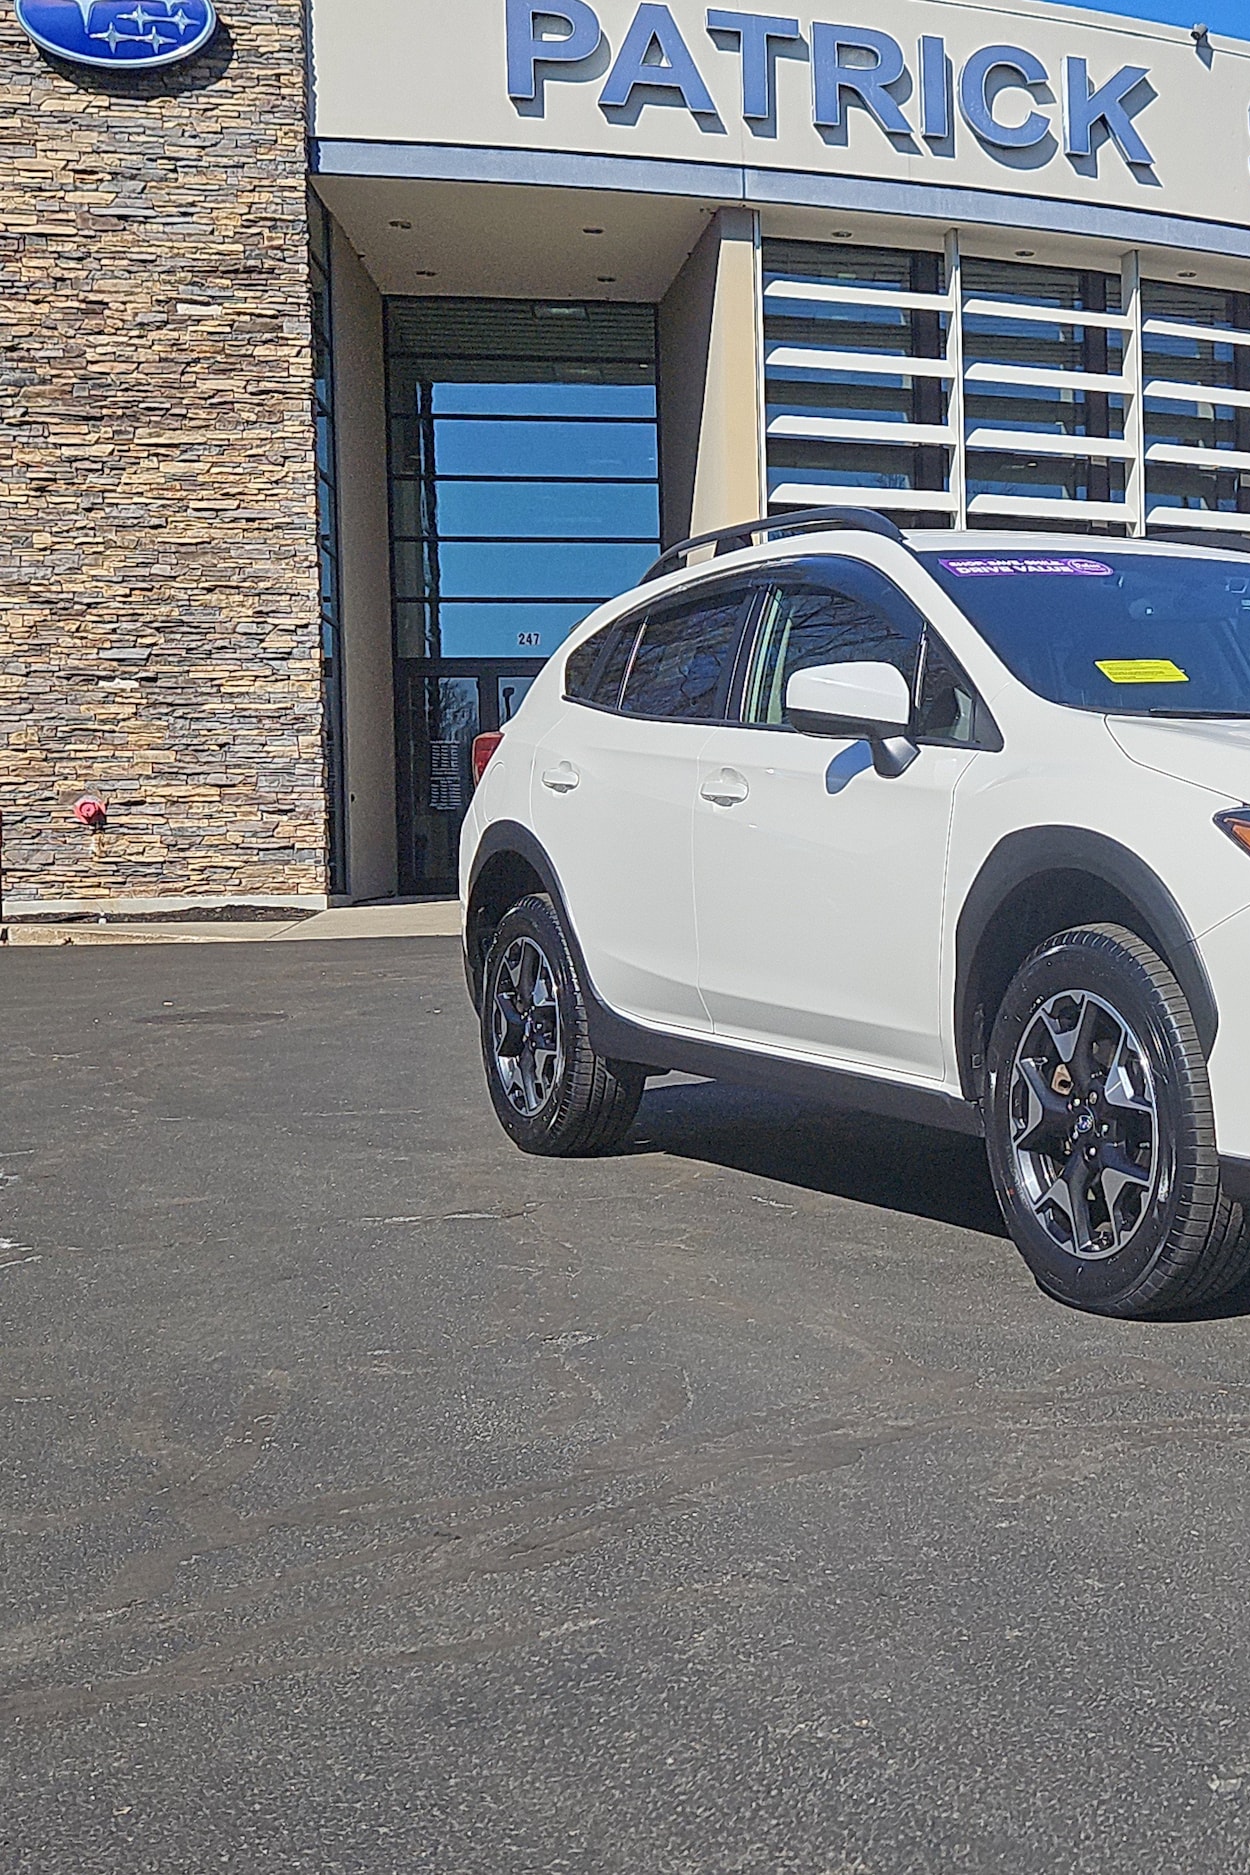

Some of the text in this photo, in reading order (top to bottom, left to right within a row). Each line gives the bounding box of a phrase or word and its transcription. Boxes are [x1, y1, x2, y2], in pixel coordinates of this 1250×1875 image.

[505, 0, 1155, 165] PATRICK
[956, 566, 1074, 574] DRIVE VALUE
[518, 632, 540, 646] 247
